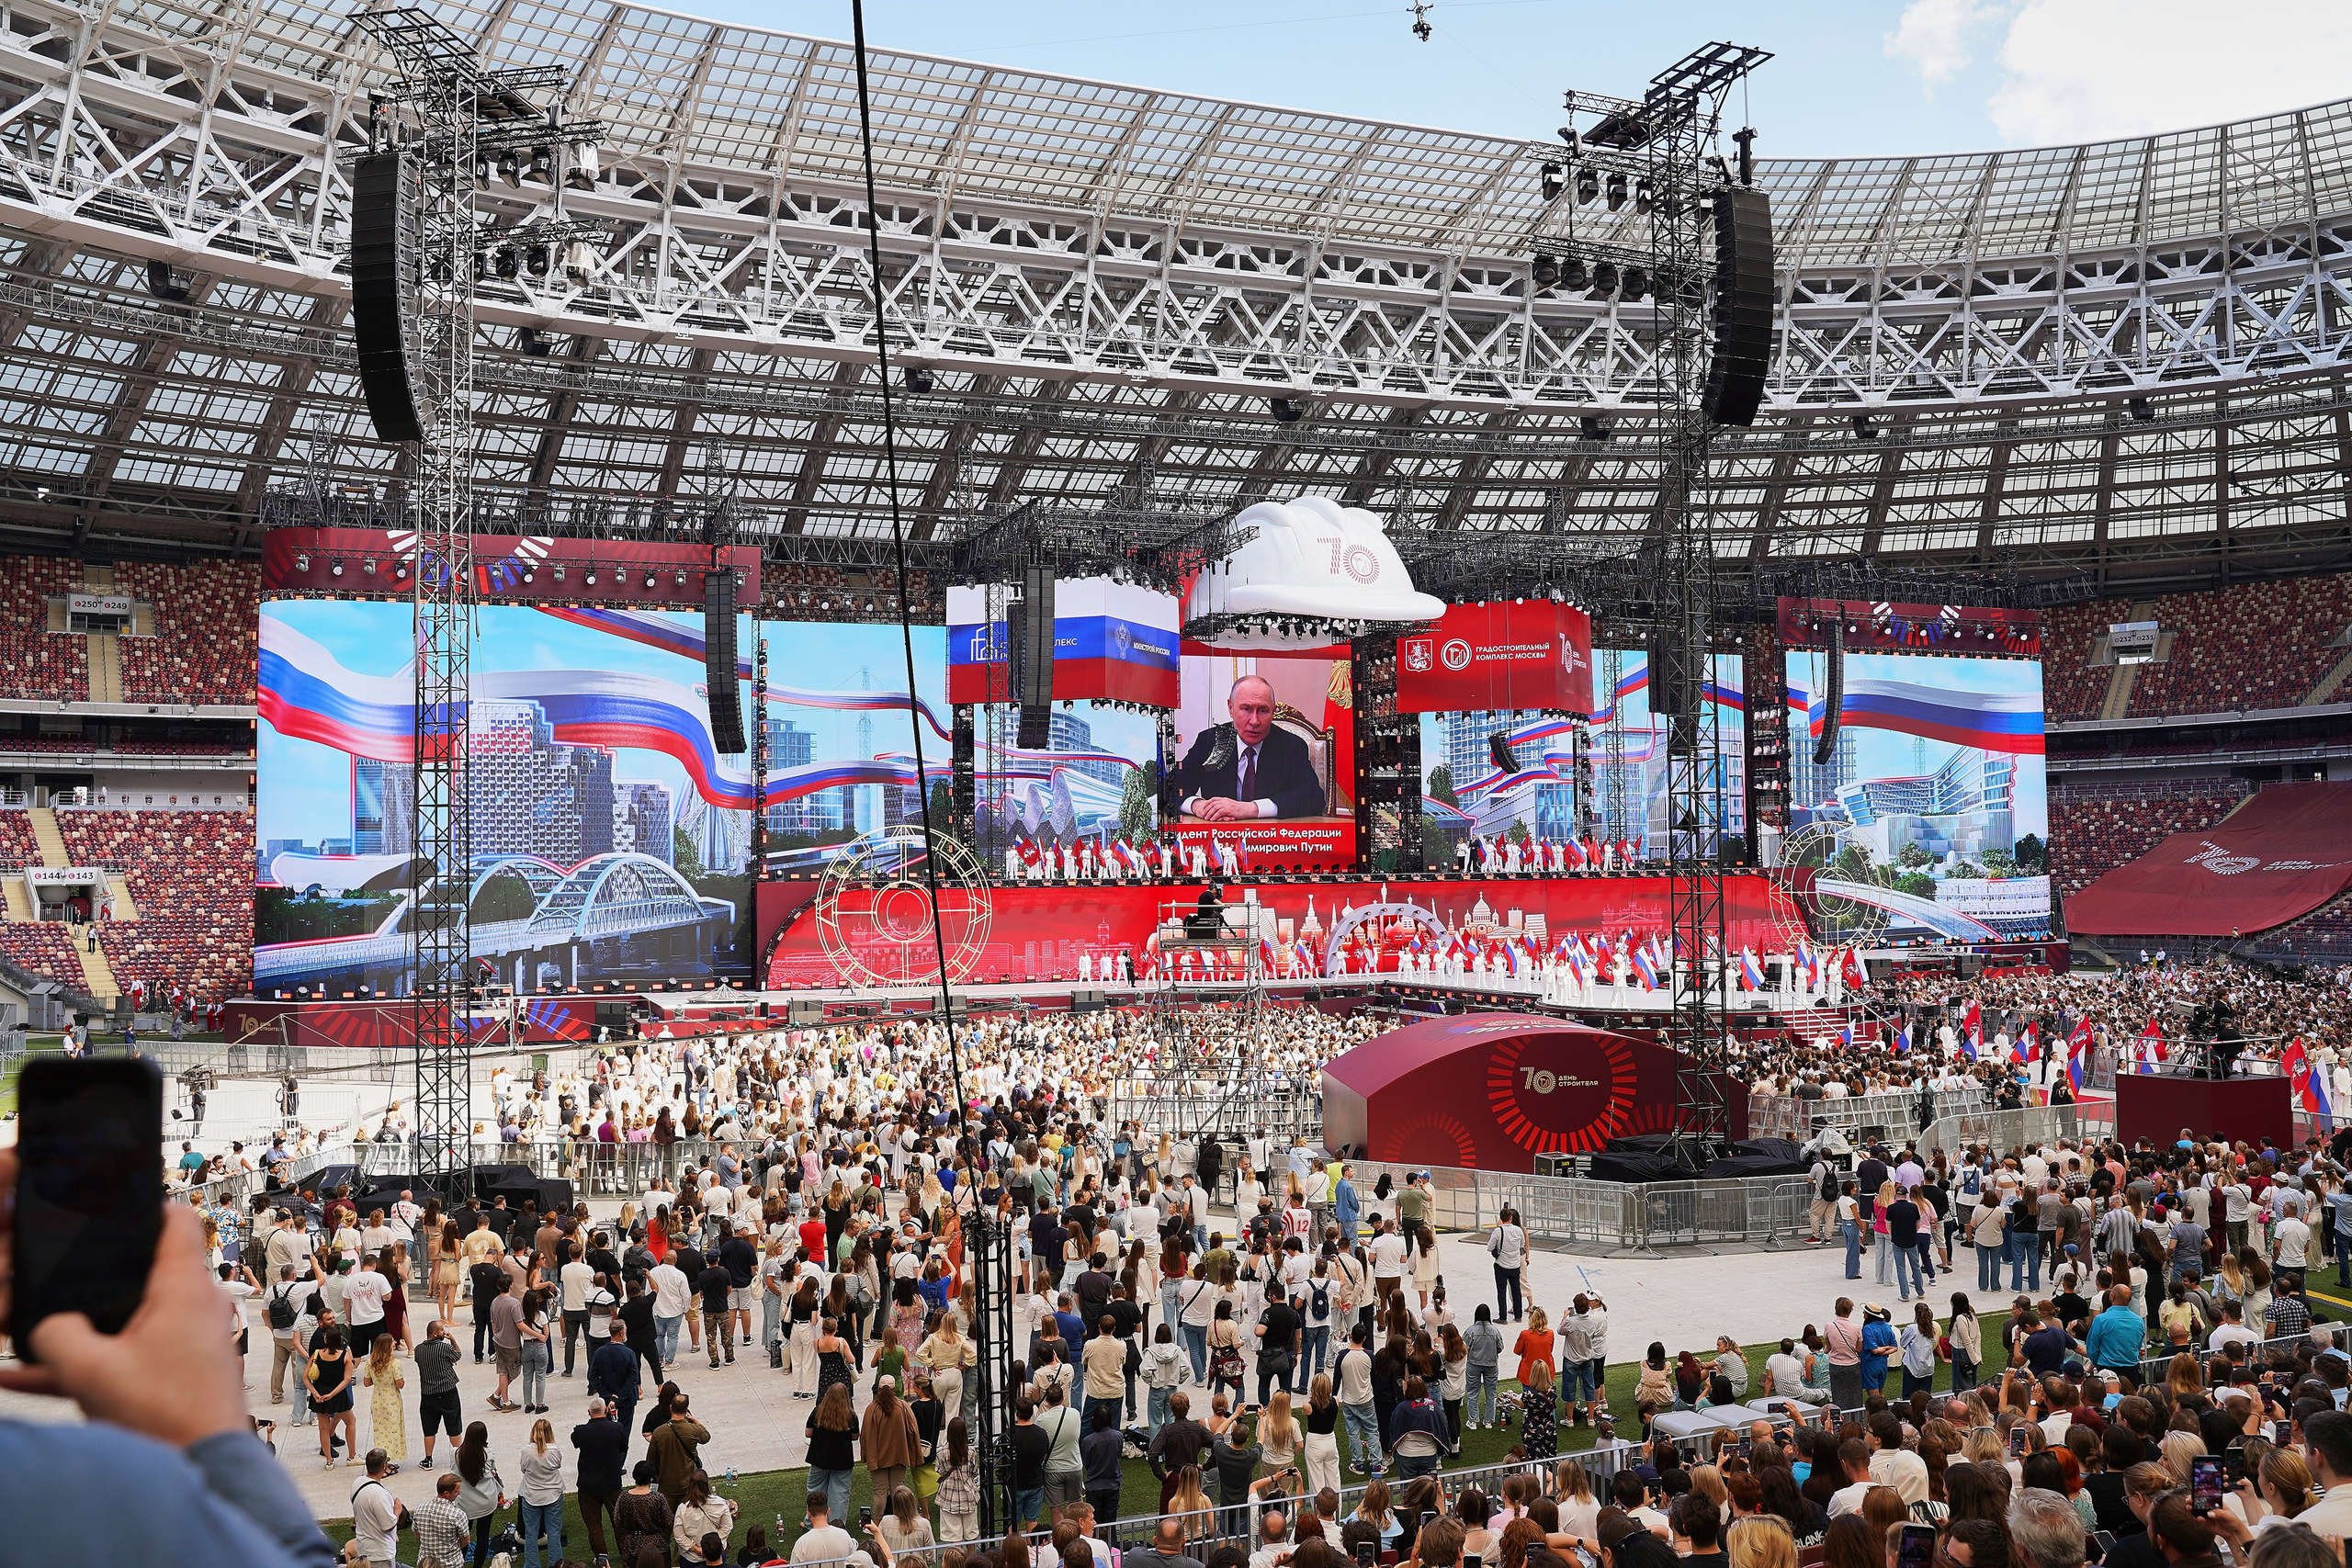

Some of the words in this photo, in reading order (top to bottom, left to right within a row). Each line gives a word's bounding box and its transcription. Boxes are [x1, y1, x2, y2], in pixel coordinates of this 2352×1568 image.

[1476, 642, 1550, 653] ГРАДОСТРОИТЕЛЬНЫЙ
[1476, 653, 1514, 661] КОМПЛЕКС
[1515, 652, 1546, 660] МОСКВЫ
[1212, 828, 1276, 839] Российской
[1279, 828, 1341, 840] Федерации
[1301, 841, 1332, 853] Путин
[1520, 1066, 1556, 1095] 70
[1296, 1220, 1309, 1232] 12
